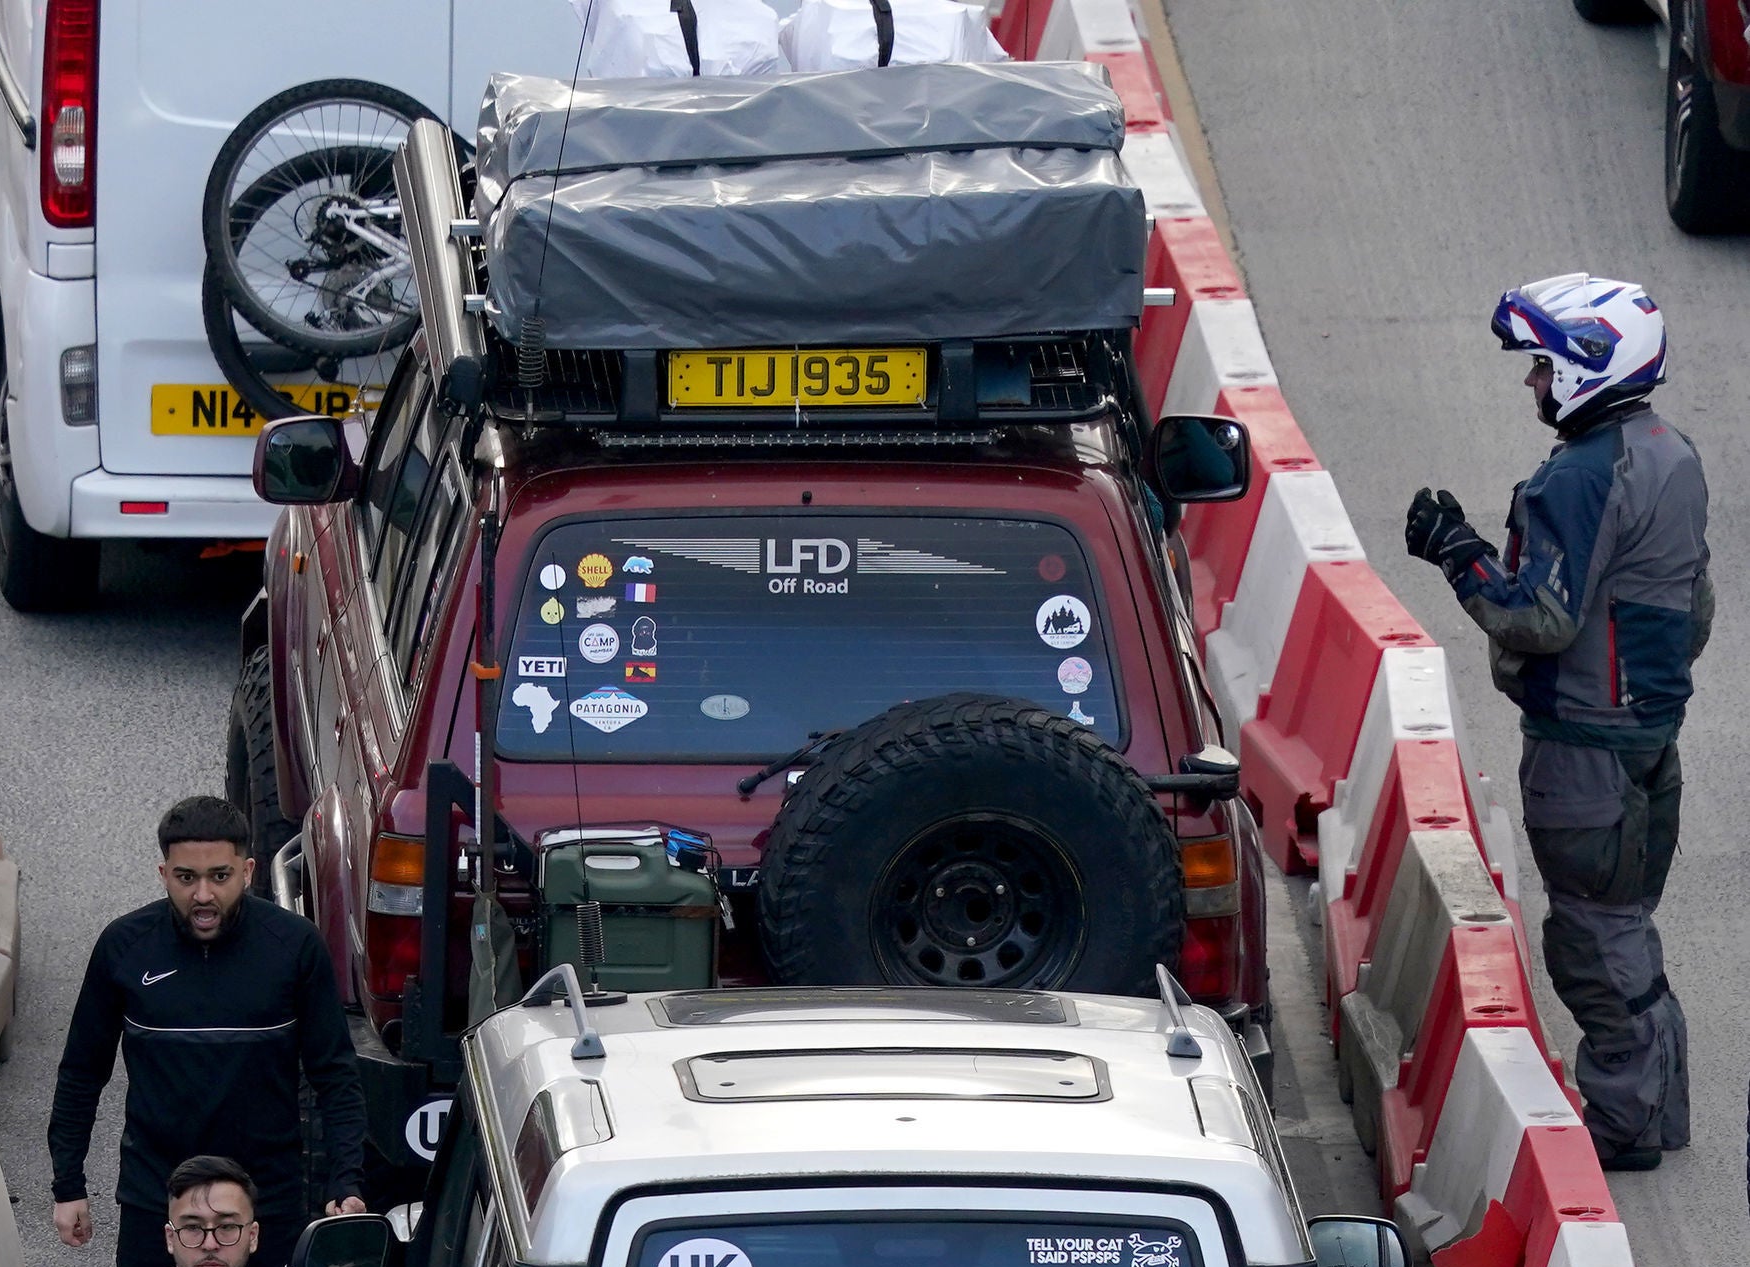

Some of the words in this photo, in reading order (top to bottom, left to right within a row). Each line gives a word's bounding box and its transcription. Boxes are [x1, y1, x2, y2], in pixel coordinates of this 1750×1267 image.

[707, 355, 775, 397] TIJ
[791, 355, 891, 397] 1935
[766, 538, 851, 574] LFD
[581, 565, 609, 575] SHELL
[768, 578, 798, 594] Off
[803, 578, 849, 594] Road
[521, 660, 563, 673] YETI
[576, 703, 641, 714] PATAGONIA
[1026, 1238, 1054, 1251] TELL
[1056, 1238, 1094, 1251] YOUR
[1096, 1238, 1124, 1251] CAT
[1030, 1252, 1035, 1264] I
[1037, 1252, 1068, 1264] SAID
[1071, 1252, 1120, 1264] PSPSPS
